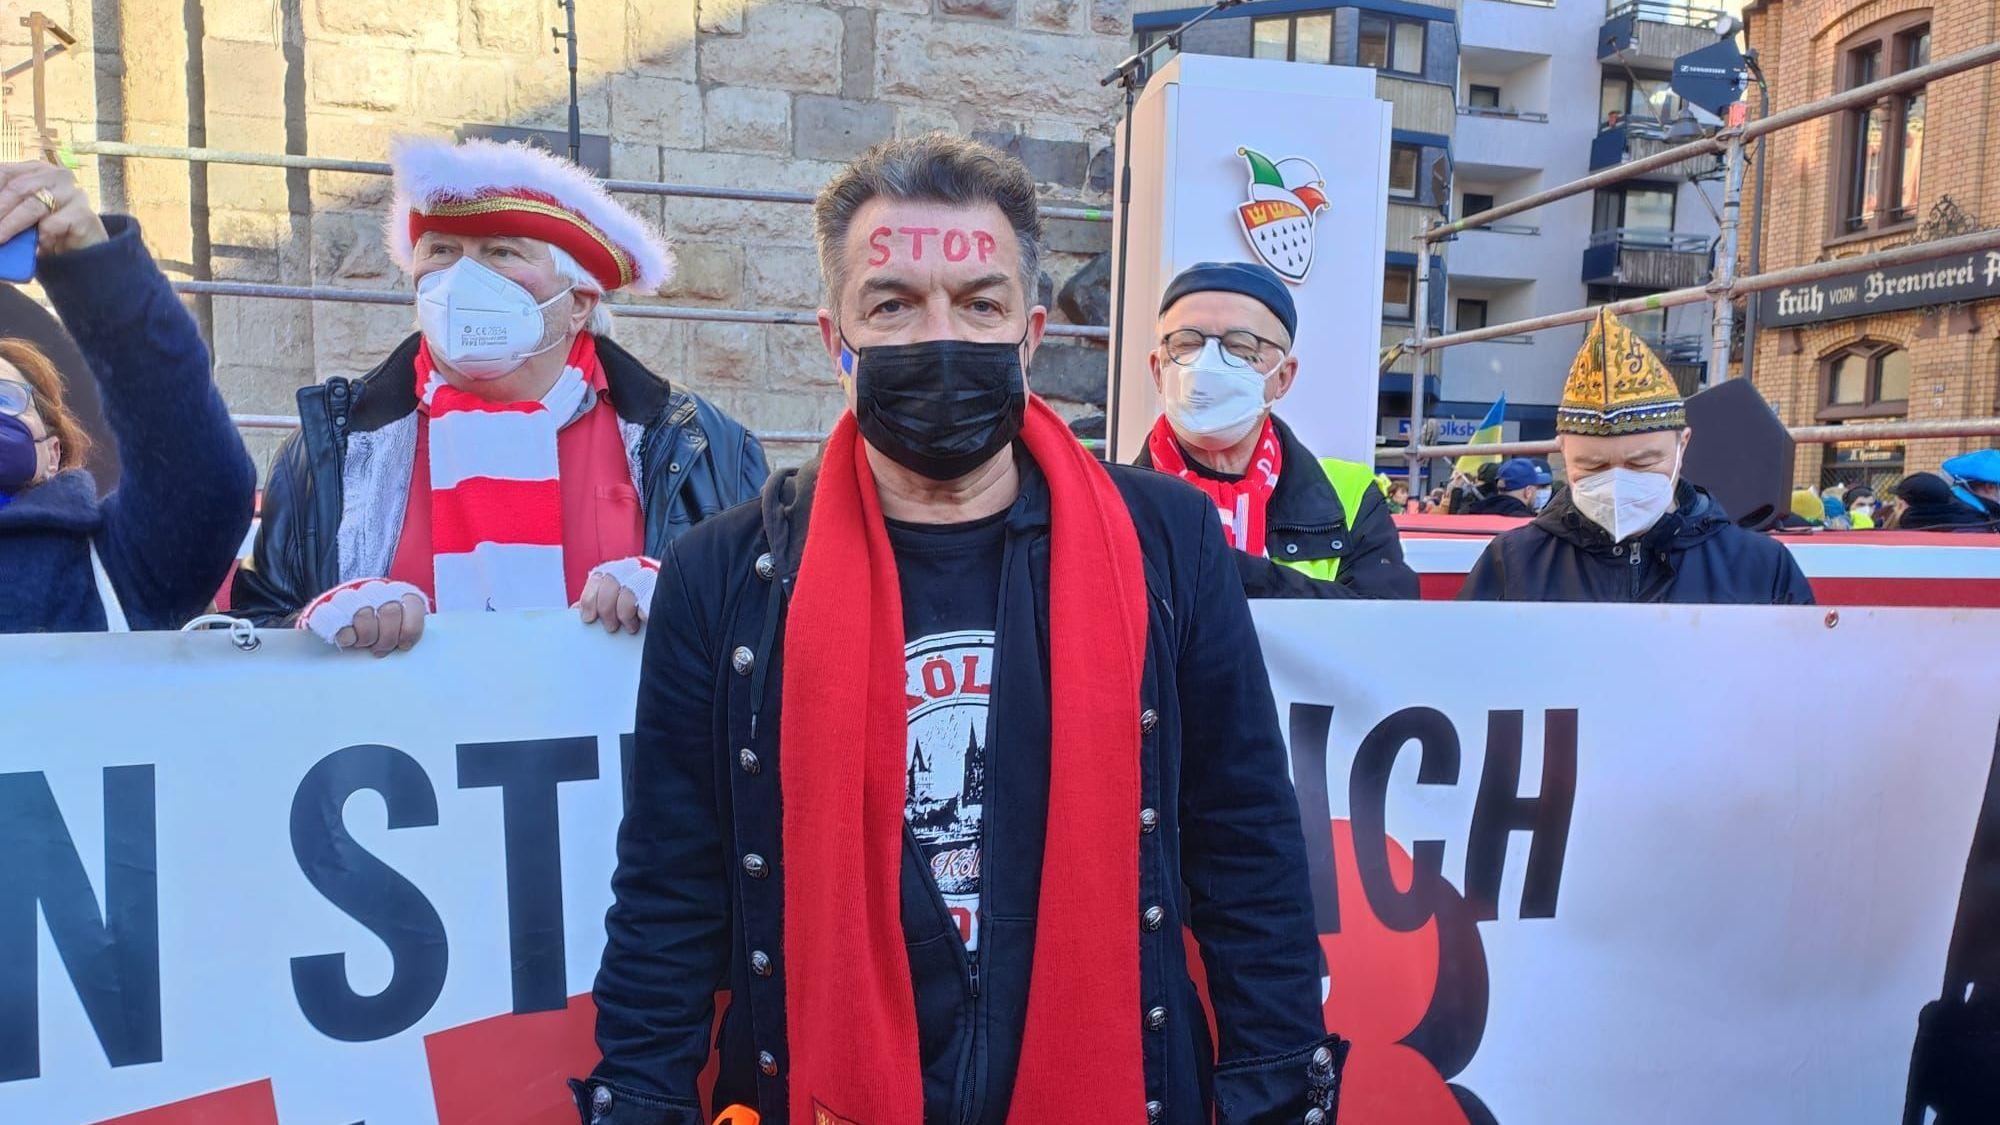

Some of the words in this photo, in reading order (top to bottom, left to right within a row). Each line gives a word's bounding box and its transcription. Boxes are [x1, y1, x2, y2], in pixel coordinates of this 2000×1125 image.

[868, 226, 996, 267] STOP
[1829, 285, 1858, 306] VORM
[1864, 256, 1975, 303] Brennerei
[1439, 420, 1476, 437] olksb
[906, 653, 992, 709] ÖL
[931, 848, 981, 879] Köl
[289, 732, 638, 1043] ST
